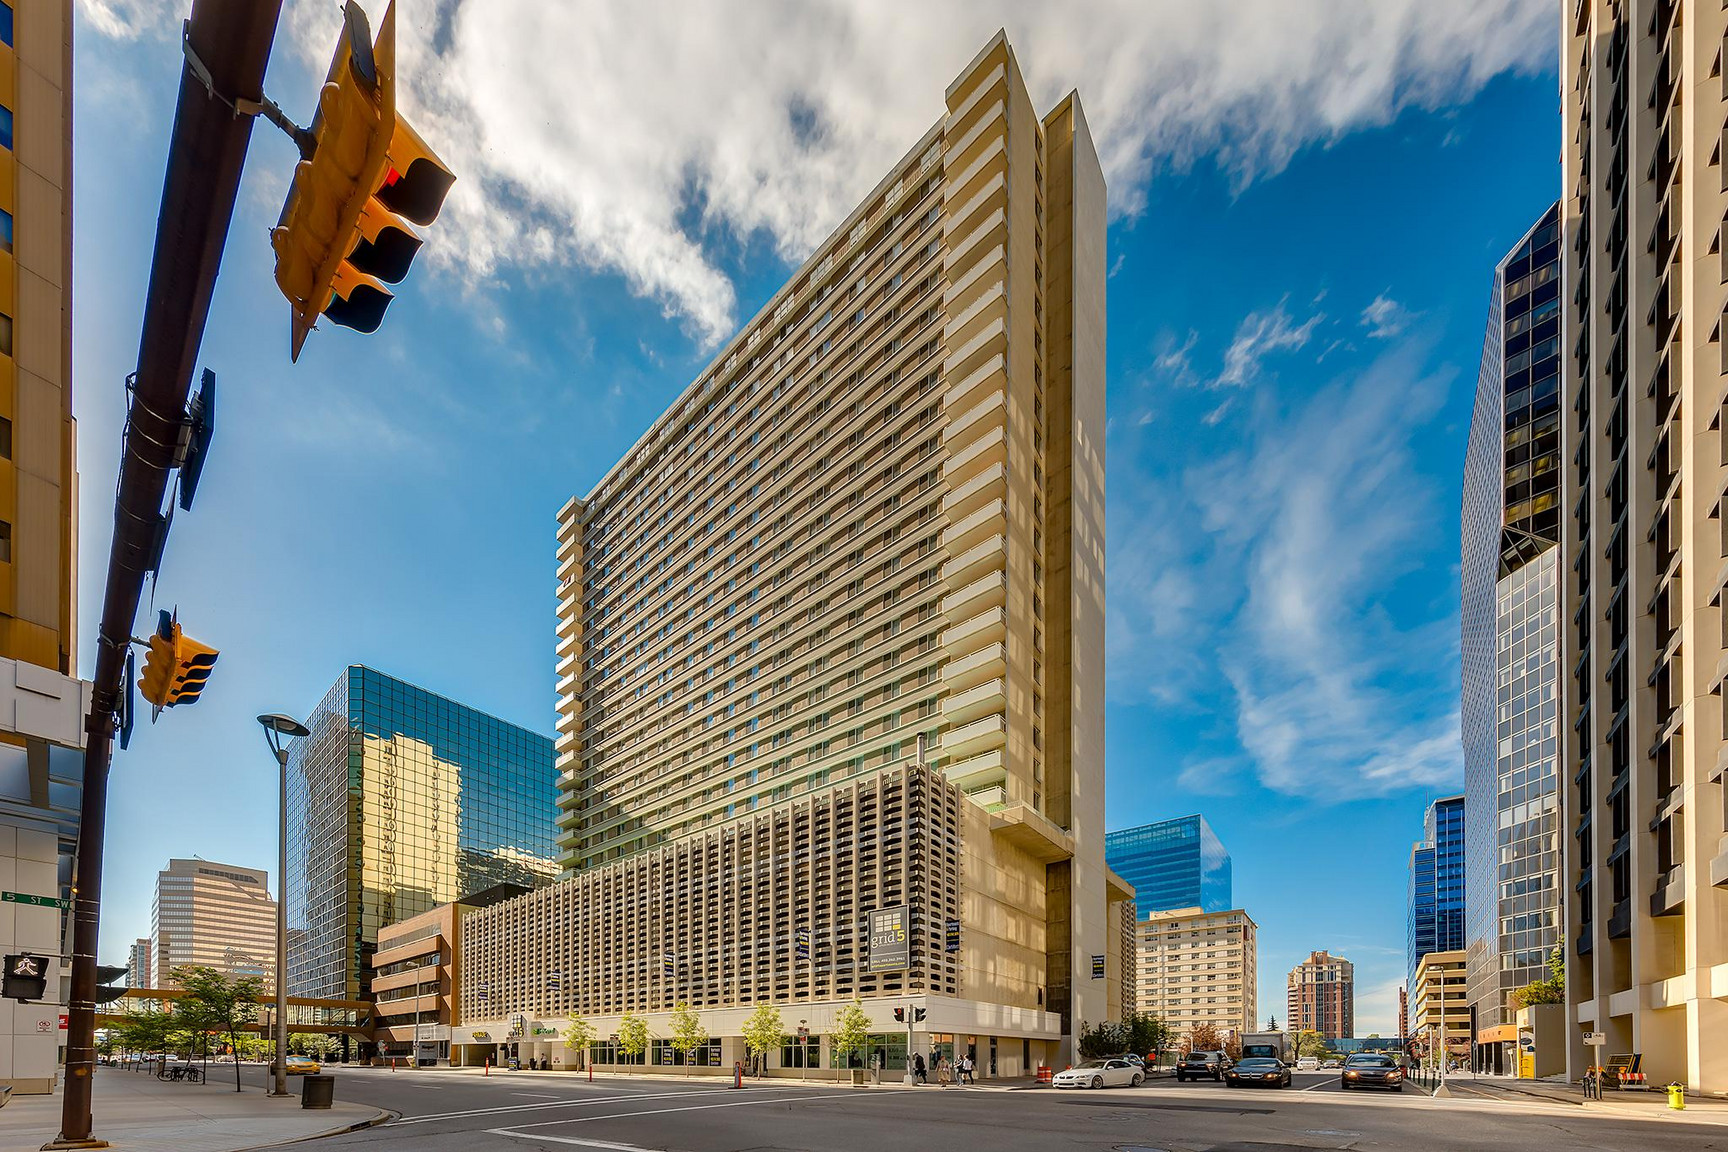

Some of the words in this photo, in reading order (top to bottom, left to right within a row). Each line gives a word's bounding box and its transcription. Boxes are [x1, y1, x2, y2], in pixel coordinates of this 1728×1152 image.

[6, 893, 16, 901] 5
[30, 896, 42, 904] ST
[54, 900, 68, 908] SW
[897, 930, 905, 942] 5
